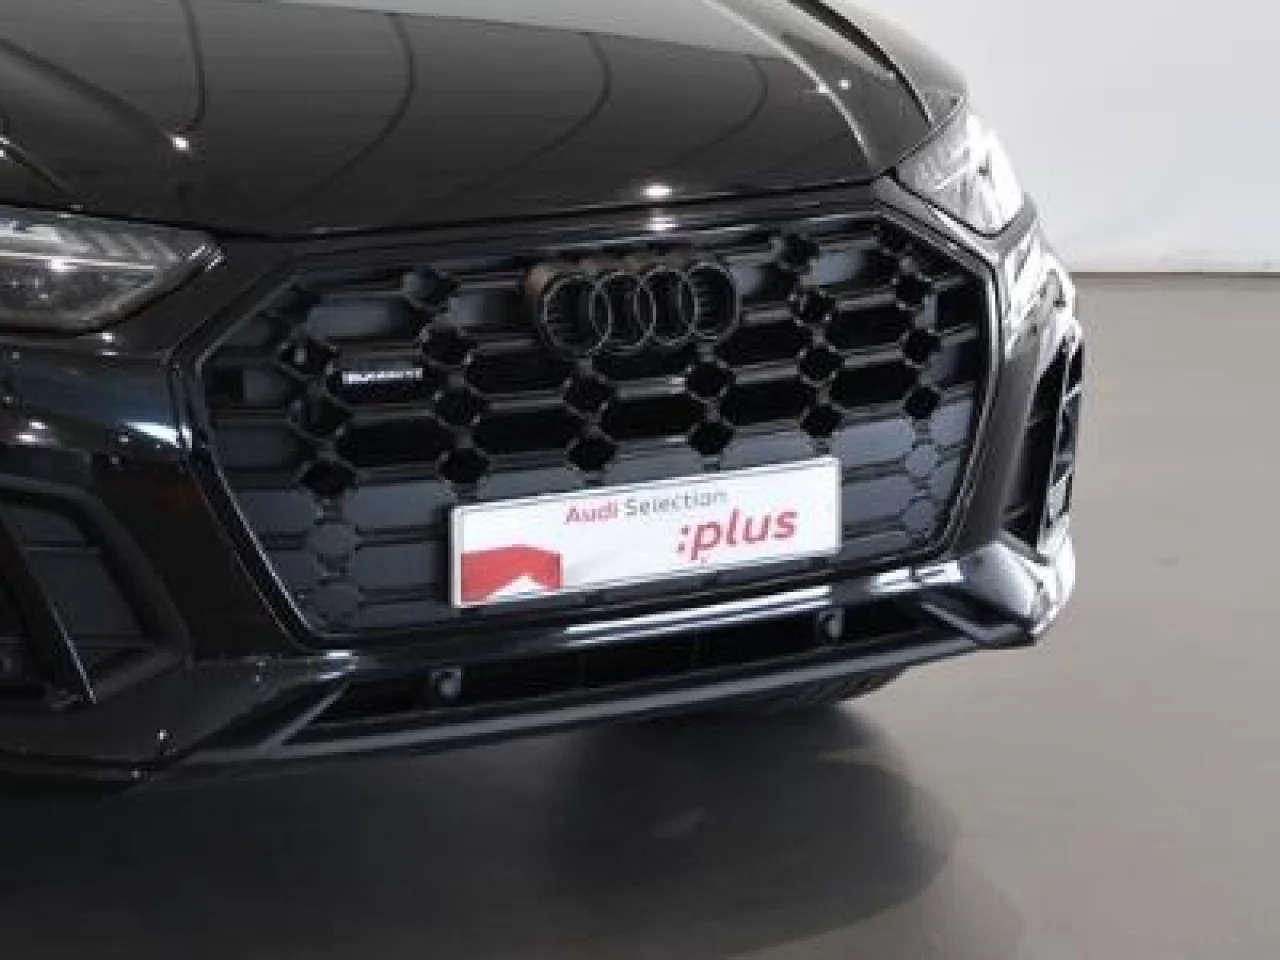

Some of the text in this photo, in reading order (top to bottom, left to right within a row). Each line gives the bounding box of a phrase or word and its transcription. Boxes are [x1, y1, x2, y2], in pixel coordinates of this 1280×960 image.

[565, 492, 727, 524] Audi Selection
[677, 507, 799, 560] :plus
